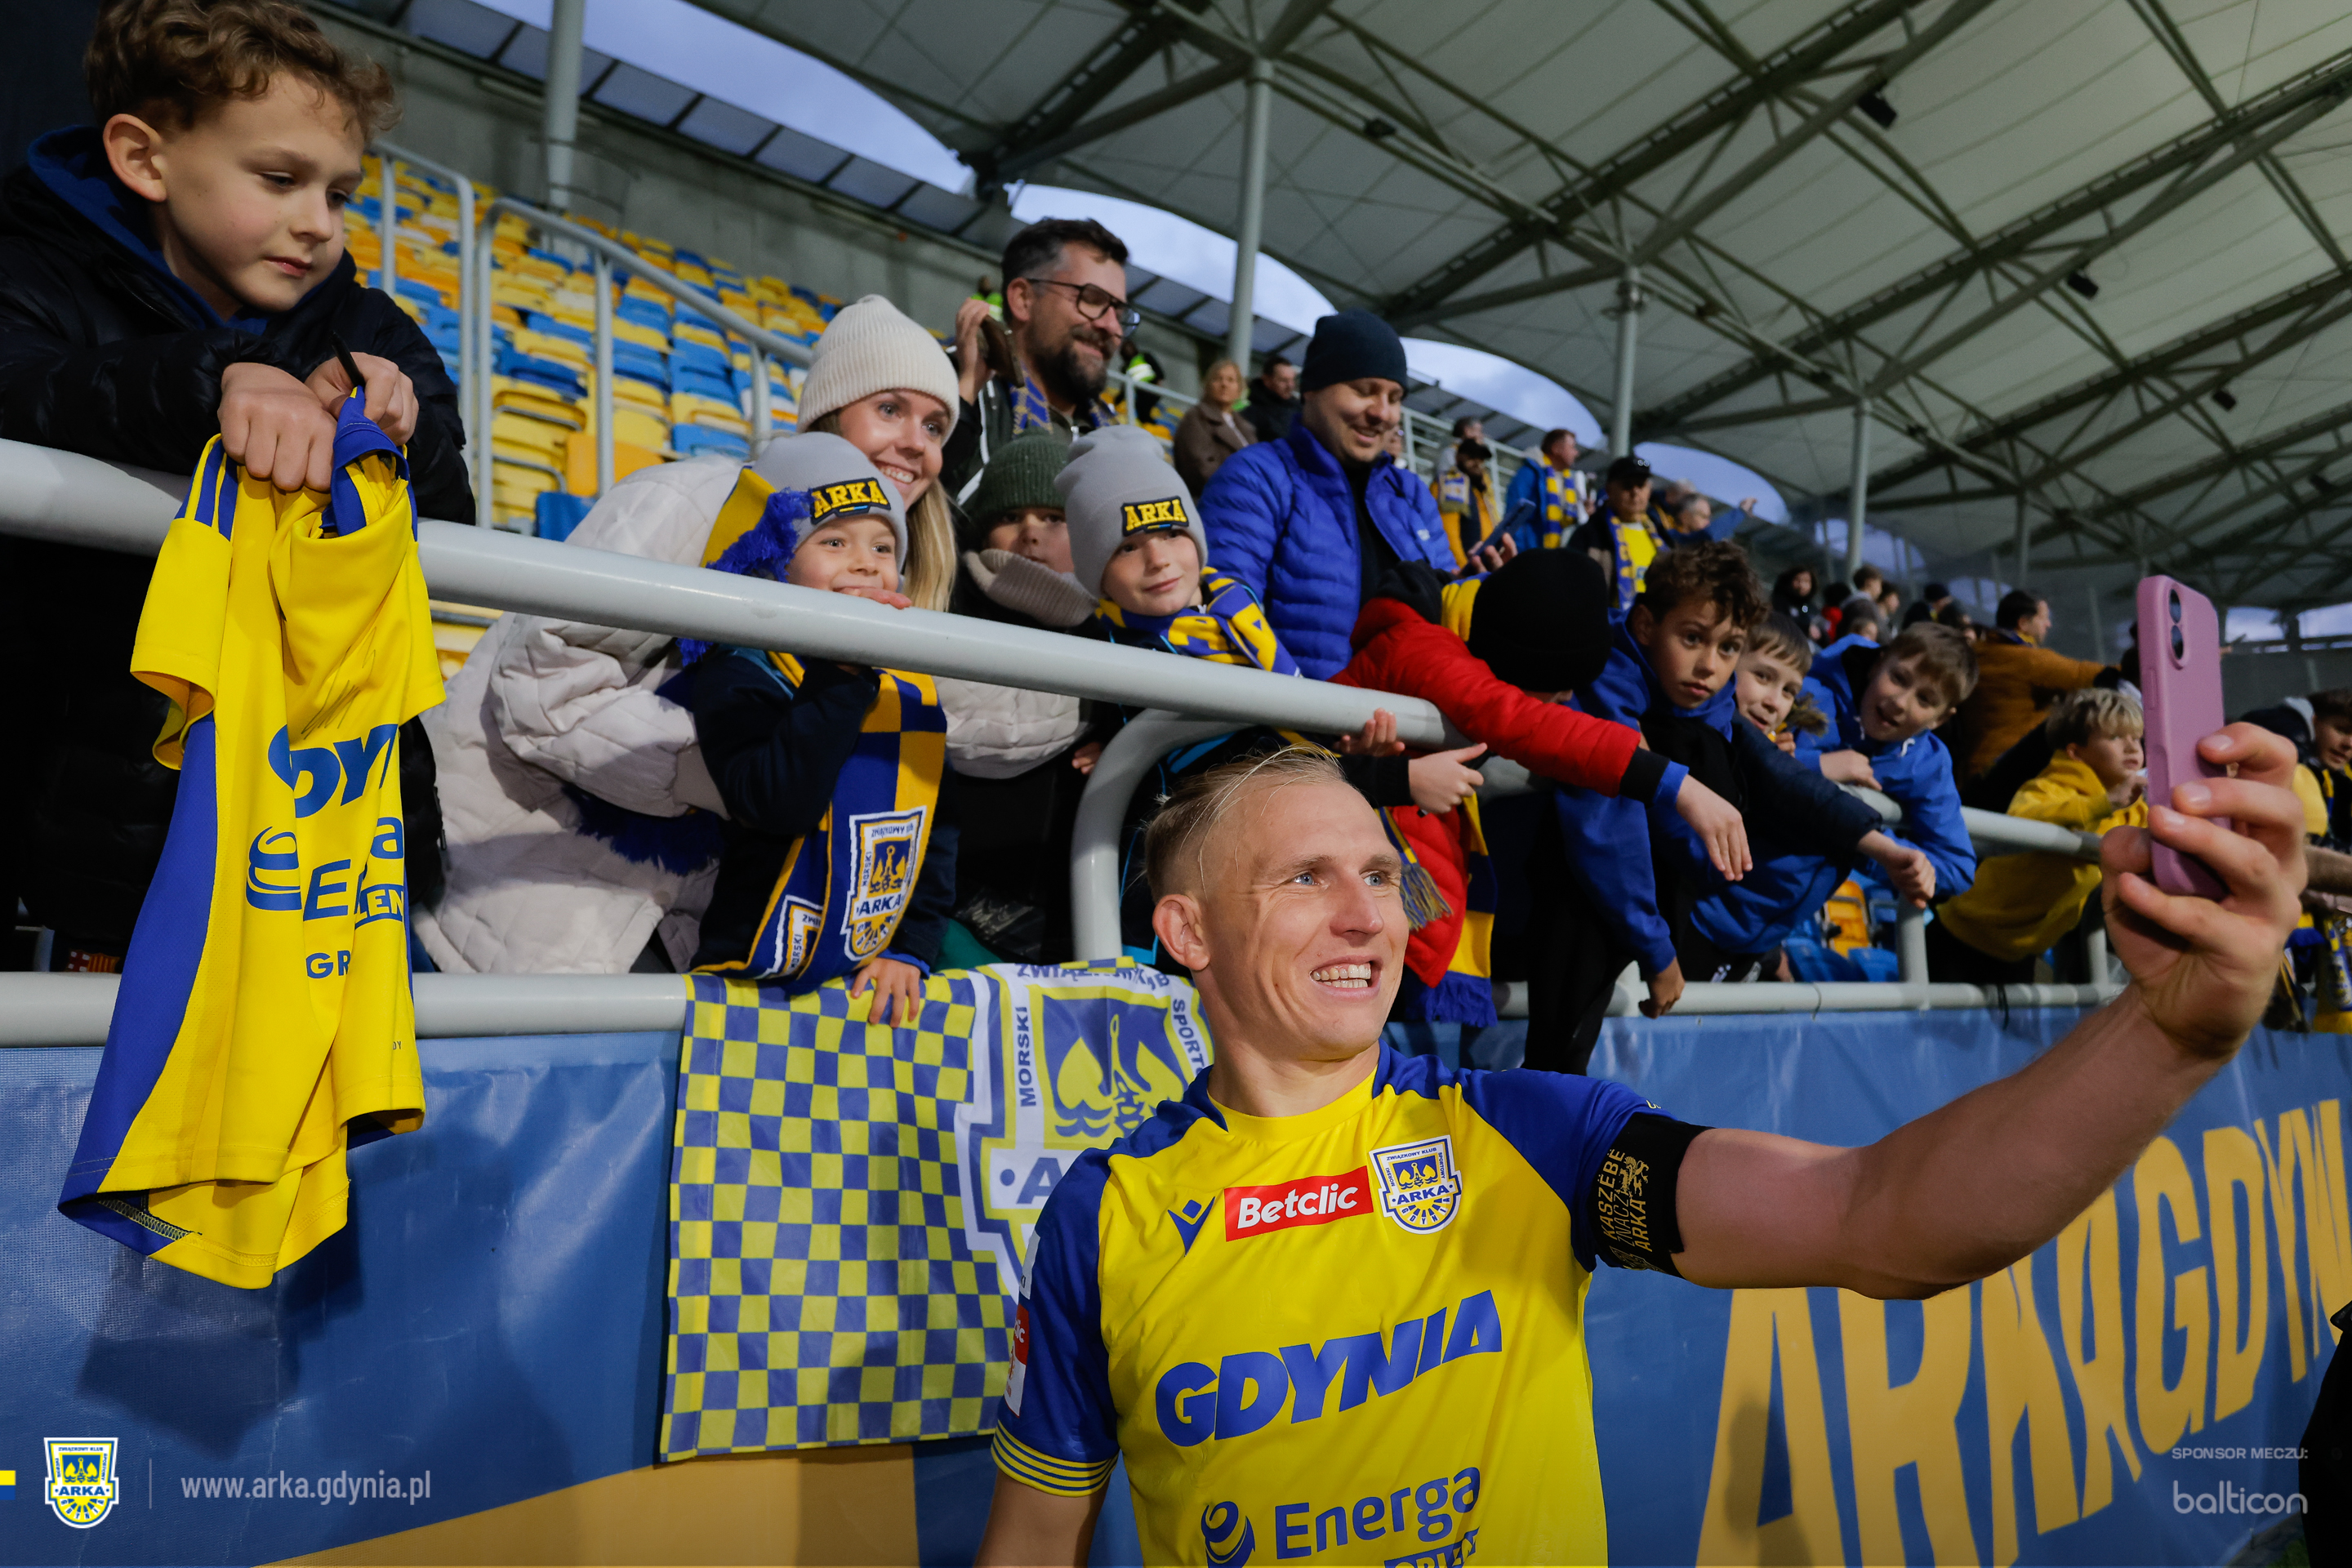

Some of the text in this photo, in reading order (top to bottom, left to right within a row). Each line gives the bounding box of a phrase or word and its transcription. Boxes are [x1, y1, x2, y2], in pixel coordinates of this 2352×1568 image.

[811, 480, 888, 519] ARKA
[1124, 499, 1187, 532] ARKA
[859, 893, 902, 915] ARKA
[1015, 1006, 1037, 1107] MORSKI
[1386, 1147, 1437, 1161] ZWIĄZKOWY KLUB
[1237, 1183, 1359, 1229] Betclic
[1397, 1185, 1450, 1205] ARKA
[1629, 1199, 1653, 1253] ARKA
[1156, 1290, 1503, 1447] GDYNIA
[1275, 1467, 1481, 1560] Energa
